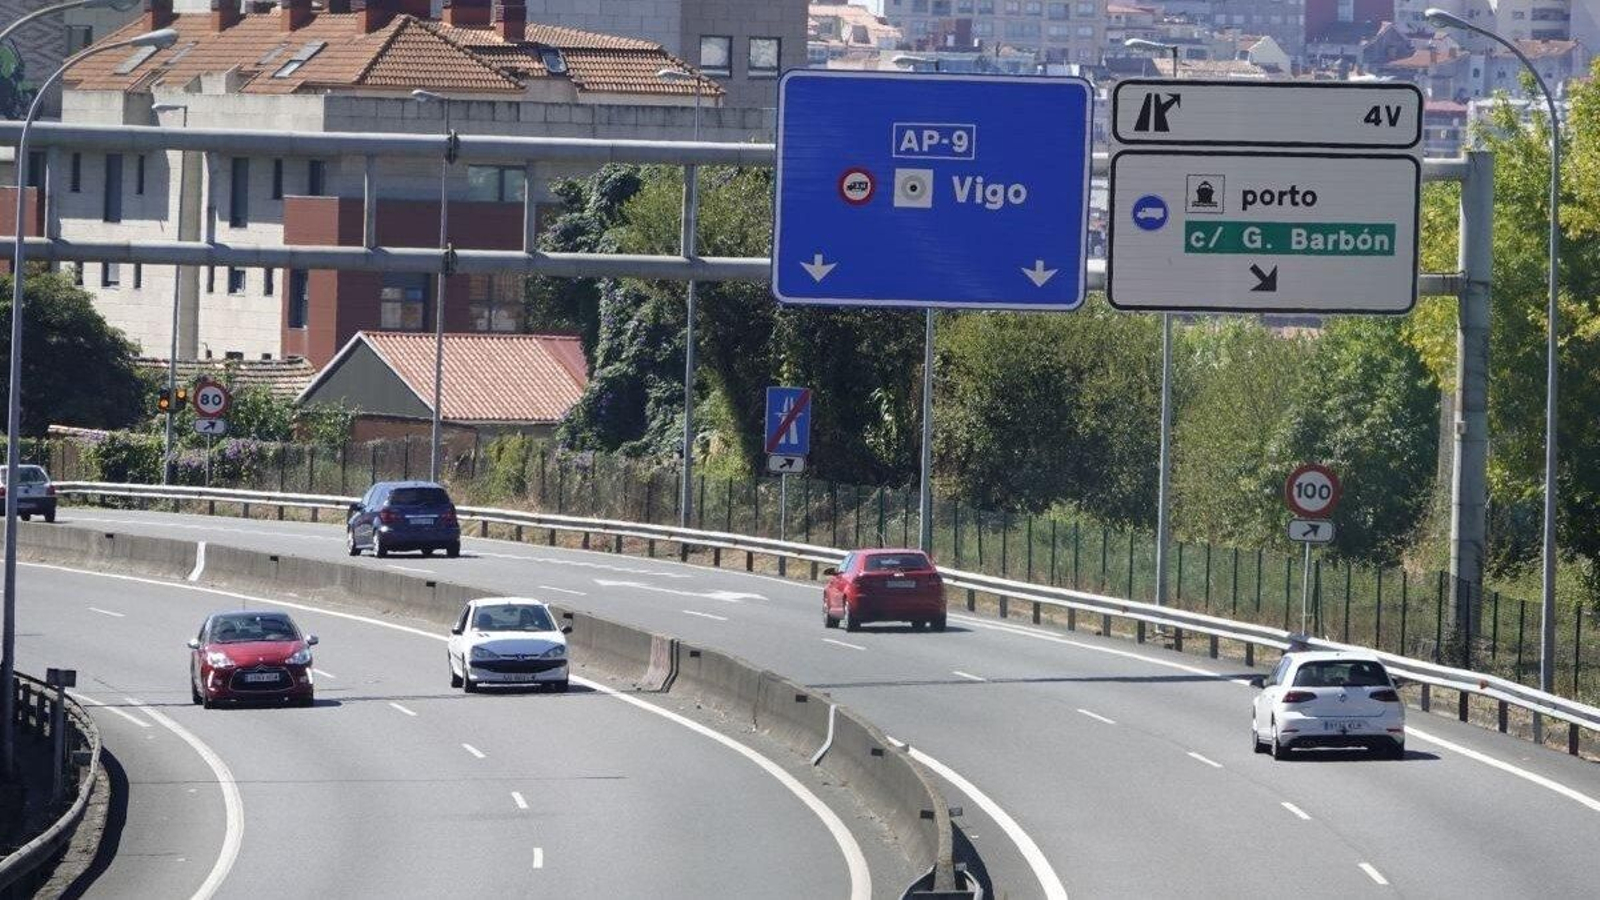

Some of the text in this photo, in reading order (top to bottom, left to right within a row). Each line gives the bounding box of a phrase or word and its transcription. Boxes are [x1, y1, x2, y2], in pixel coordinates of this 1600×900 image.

[1363, 105, 1402, 127] 4V
[900, 129, 969, 153] AP-9
[952, 175, 1027, 210] Vigo
[1241, 185, 1318, 211] porto
[1190, 226, 1389, 251] c/ G. Barbón
[200, 393, 222, 406] 80
[1295, 482, 1331, 500] 100
